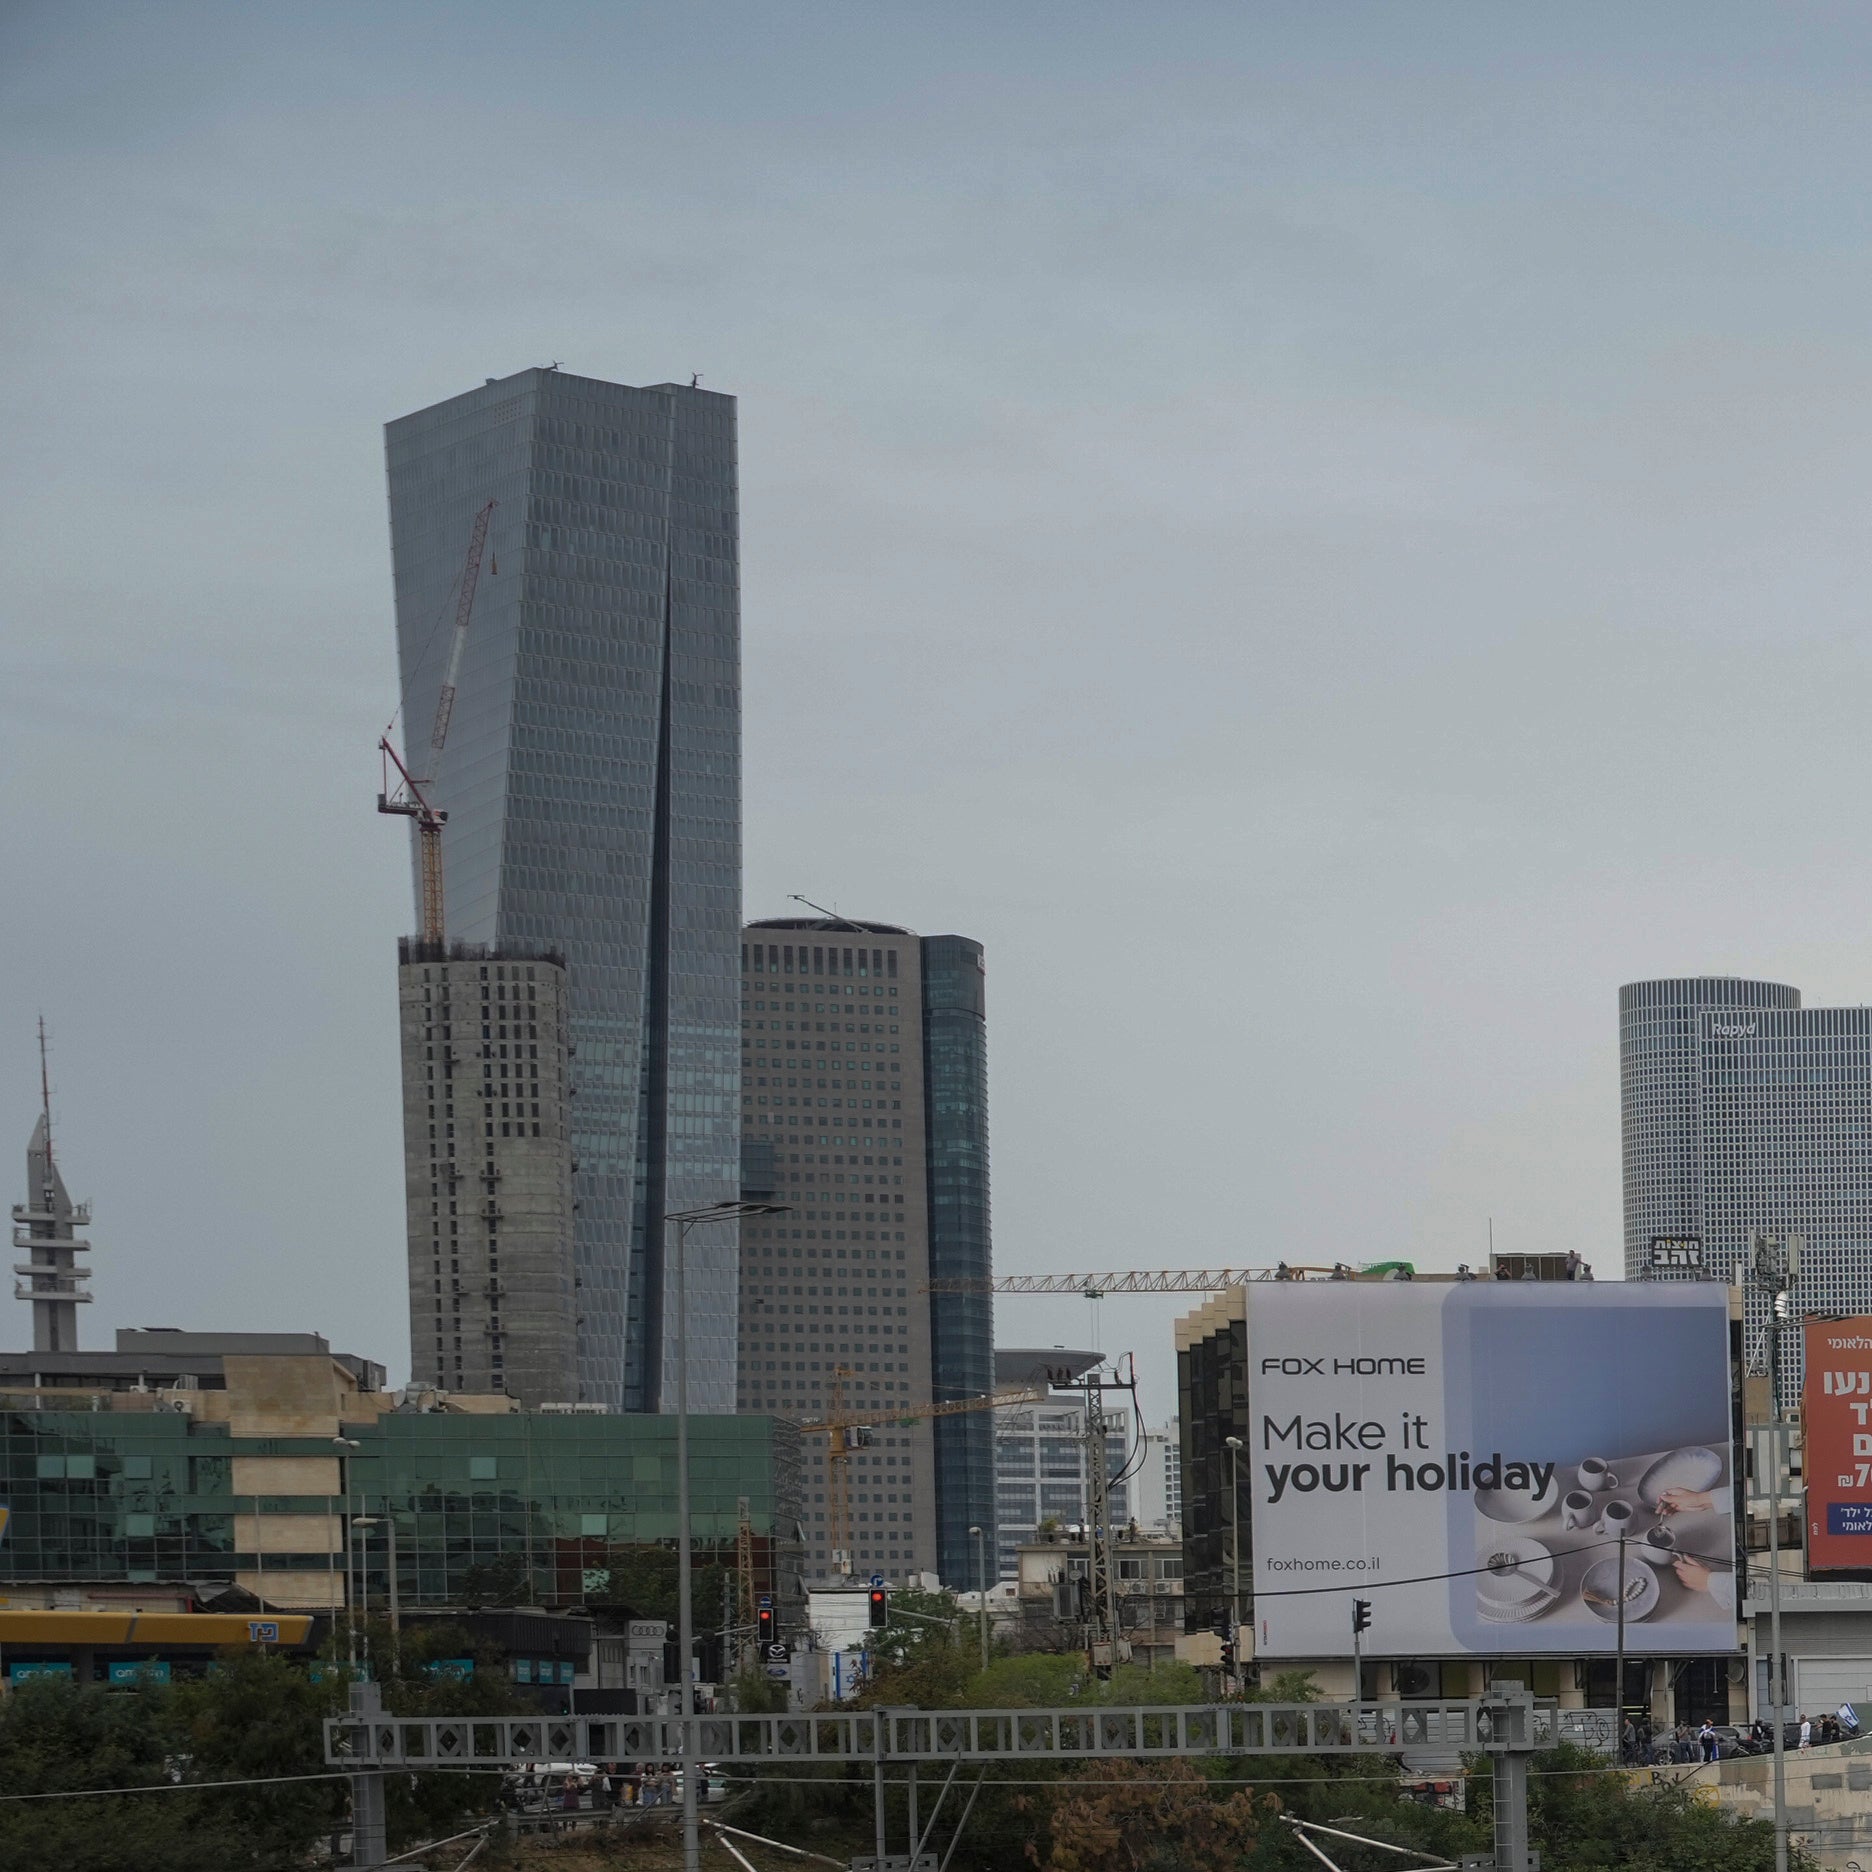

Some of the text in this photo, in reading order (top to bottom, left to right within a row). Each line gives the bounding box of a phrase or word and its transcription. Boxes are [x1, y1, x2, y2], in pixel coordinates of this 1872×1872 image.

[1713, 1022, 1756, 1038] Rapyd
[1654, 1250, 1699, 1265] זהב
[1827, 1335, 1872, 1349] הלאומי
[1262, 1358, 1425, 1375] FOX HOME
[1263, 1412, 1429, 1450] Make it
[1264, 1451, 1555, 1504] your holiday
[1267, 1557, 1380, 1571] foxhome.co.il
